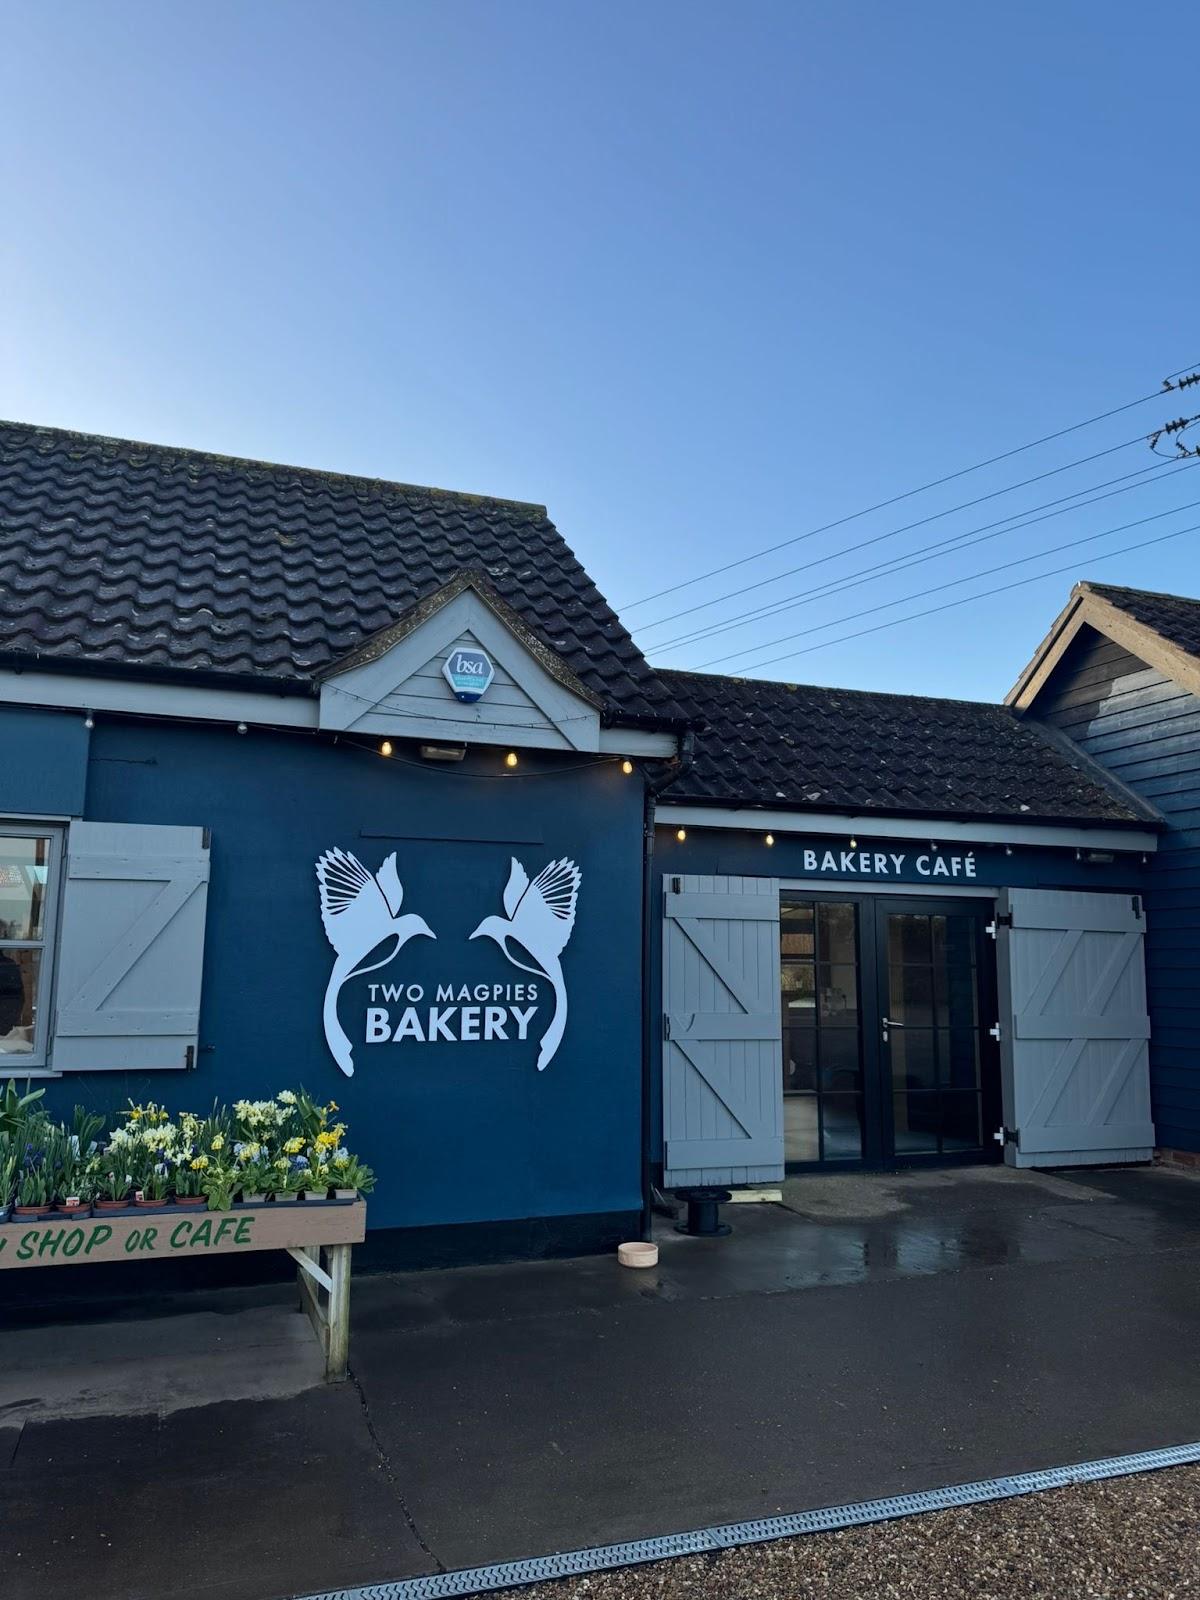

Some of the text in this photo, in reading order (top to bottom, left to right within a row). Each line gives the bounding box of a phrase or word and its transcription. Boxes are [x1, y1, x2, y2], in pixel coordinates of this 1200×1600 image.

[456, 654, 483, 674] bsa
[803, 849, 977, 878] BAKERY CAFÉ
[368, 984, 538, 1002] TWO MAGPIES
[365, 1006, 540, 1043] BAKERY
[16, 1224, 113, 1260] SHOP
[125, 1227, 158, 1253] OR
[170, 1216, 256, 1249] CAFE
